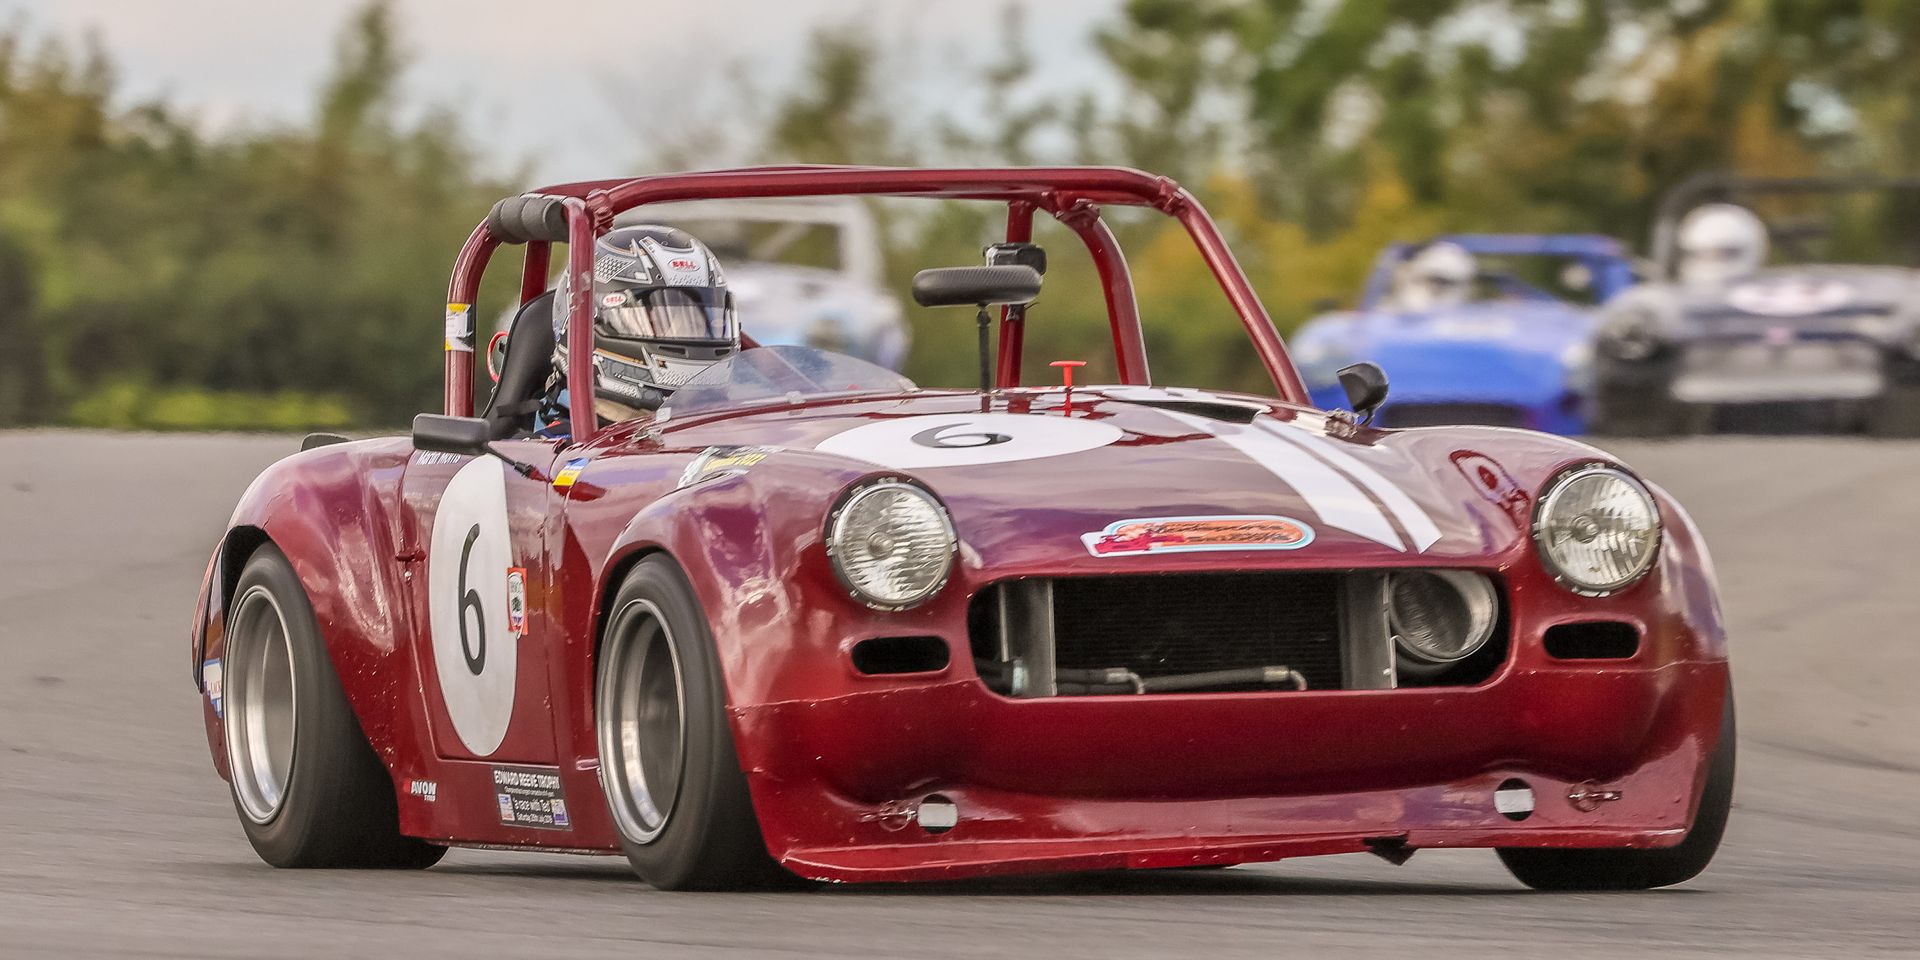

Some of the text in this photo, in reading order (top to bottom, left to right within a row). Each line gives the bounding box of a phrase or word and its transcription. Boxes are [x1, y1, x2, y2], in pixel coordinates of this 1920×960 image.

[672, 260, 696, 269] BELL
[910, 422, 1013, 448] 6
[458, 523, 486, 676] 6
[411, 780, 437, 795] AVON
[494, 770, 560, 789] EDWARD REEVE TROPHY
